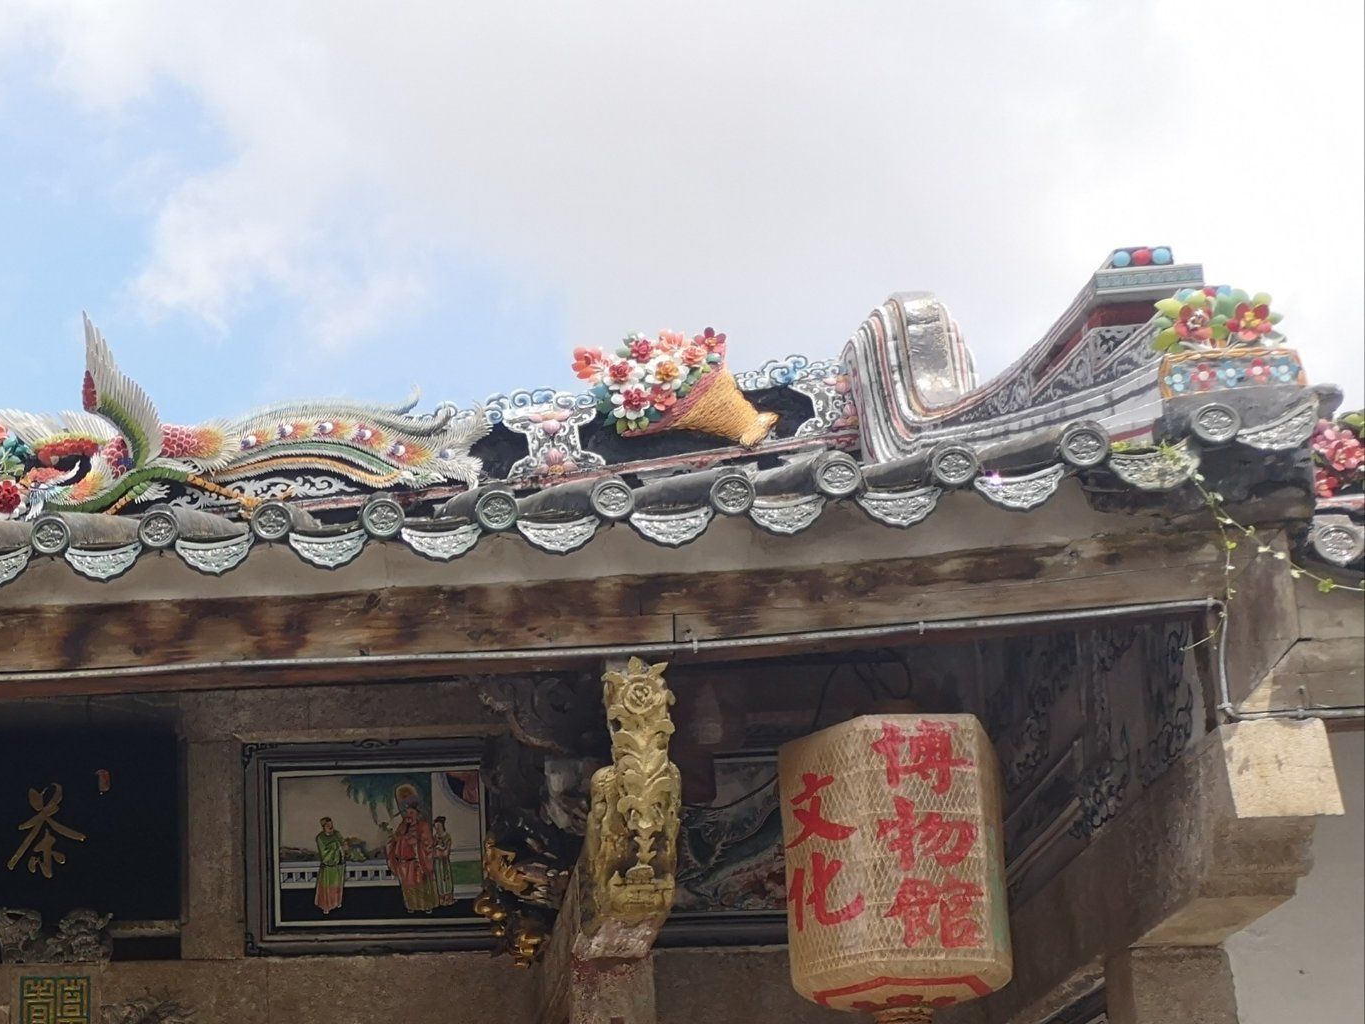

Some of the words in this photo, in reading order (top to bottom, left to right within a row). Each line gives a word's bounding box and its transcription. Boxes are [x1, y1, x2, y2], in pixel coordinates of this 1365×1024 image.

[785, 772, 865, 933] 文化
[871, 719, 984, 950] 博物館
